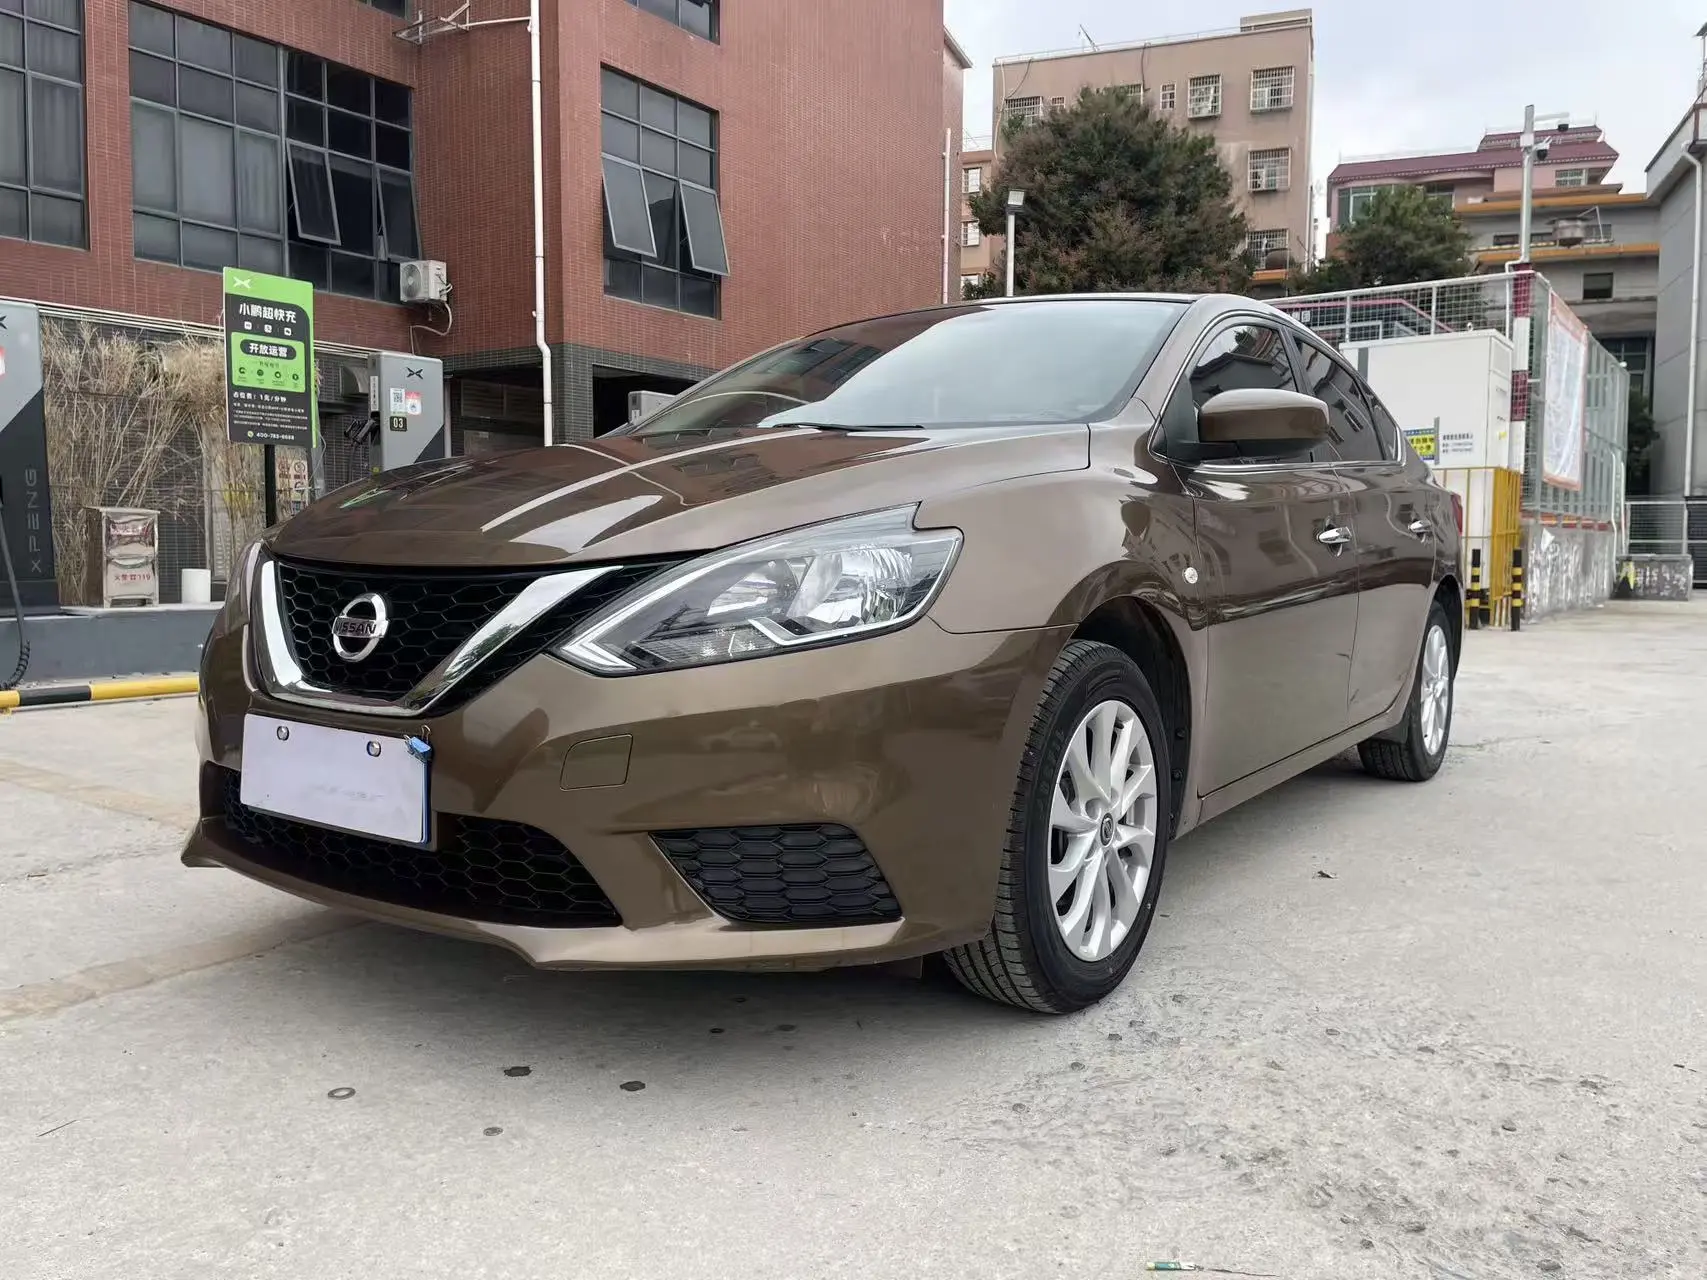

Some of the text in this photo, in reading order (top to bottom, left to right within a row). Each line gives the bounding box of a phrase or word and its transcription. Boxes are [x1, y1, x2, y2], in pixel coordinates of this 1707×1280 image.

[239, 303, 297, 324] 小鹏超快充
[249, 342, 288, 358] 开放运营
[393, 417, 404, 428] 03
[25, 468, 41, 573] XPENG
[334, 620, 376, 634] NISSAN
